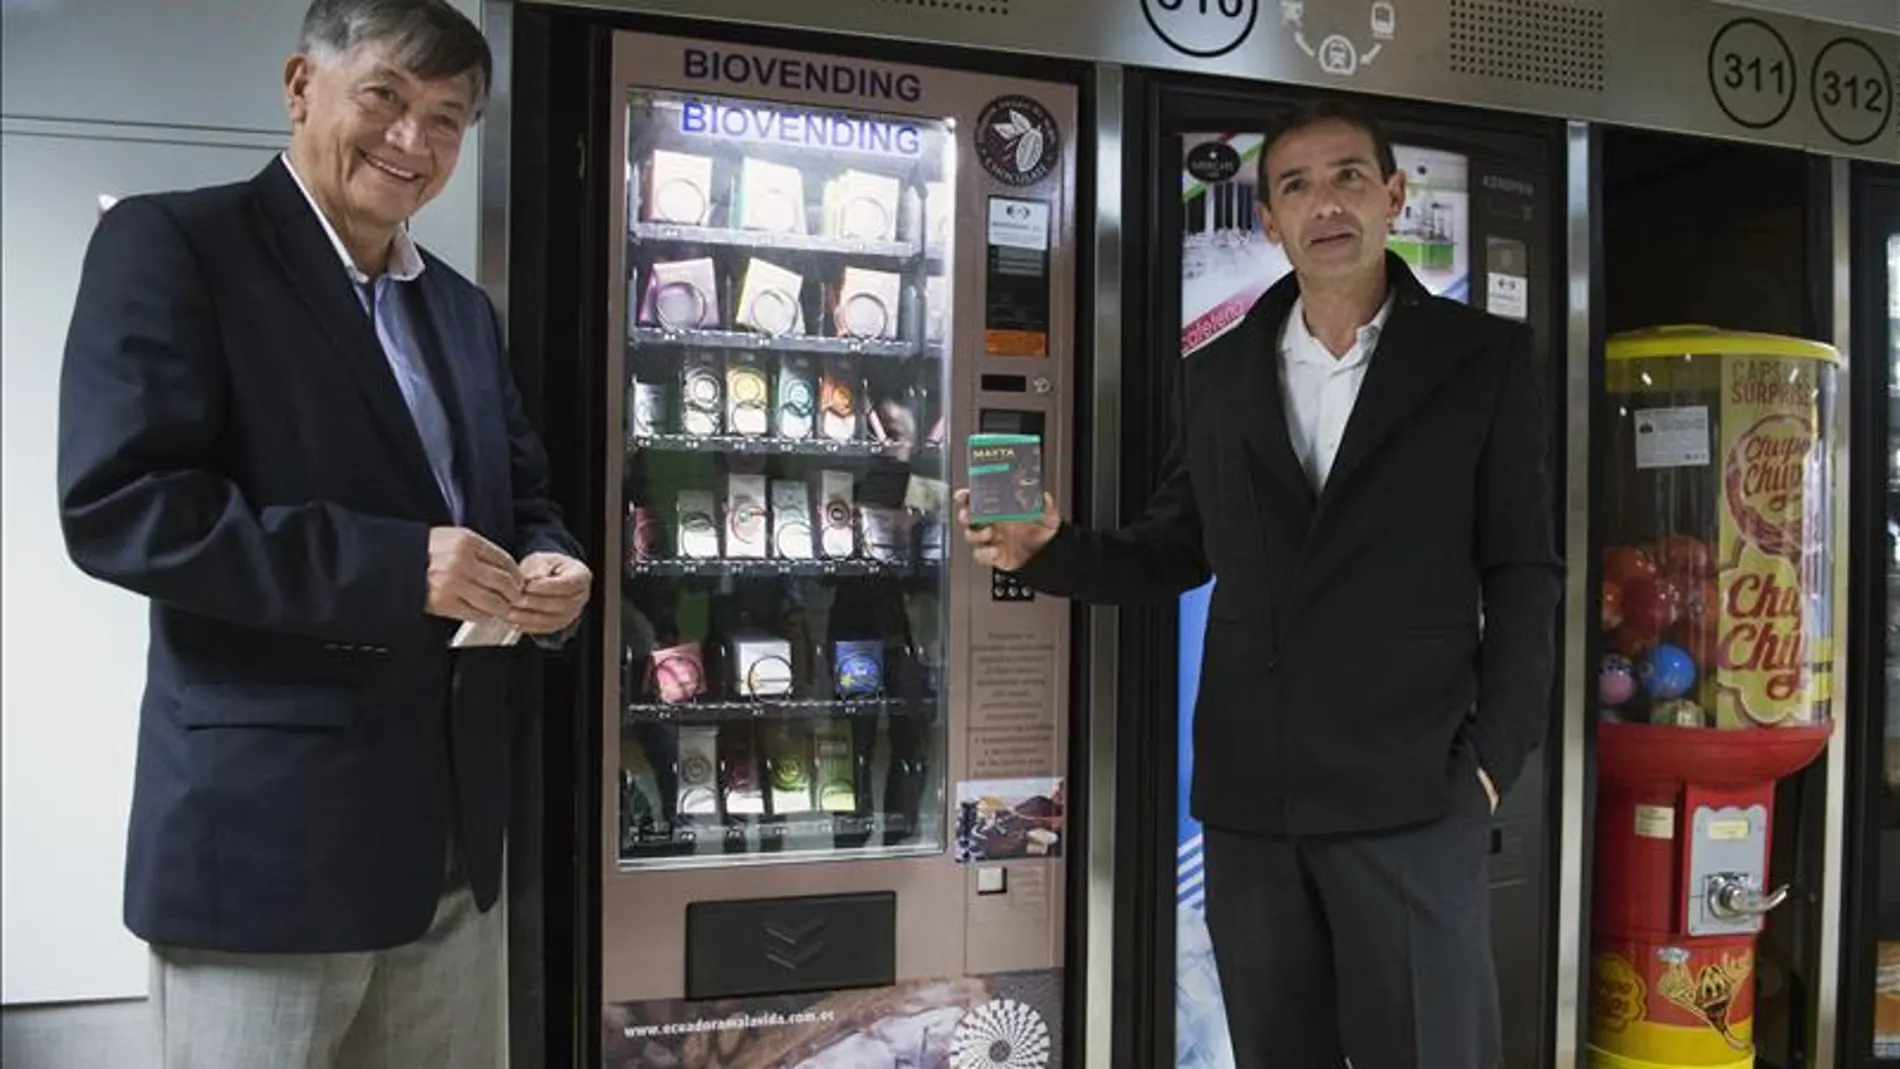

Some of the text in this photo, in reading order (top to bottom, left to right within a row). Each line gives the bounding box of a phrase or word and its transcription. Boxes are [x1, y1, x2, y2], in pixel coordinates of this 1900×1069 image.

[683, 49, 922, 102] BIOVENDING
[1724, 52, 1785, 96] 311
[1822, 70, 1883, 114] 312
[682, 102, 921, 155] BIOVENDING
